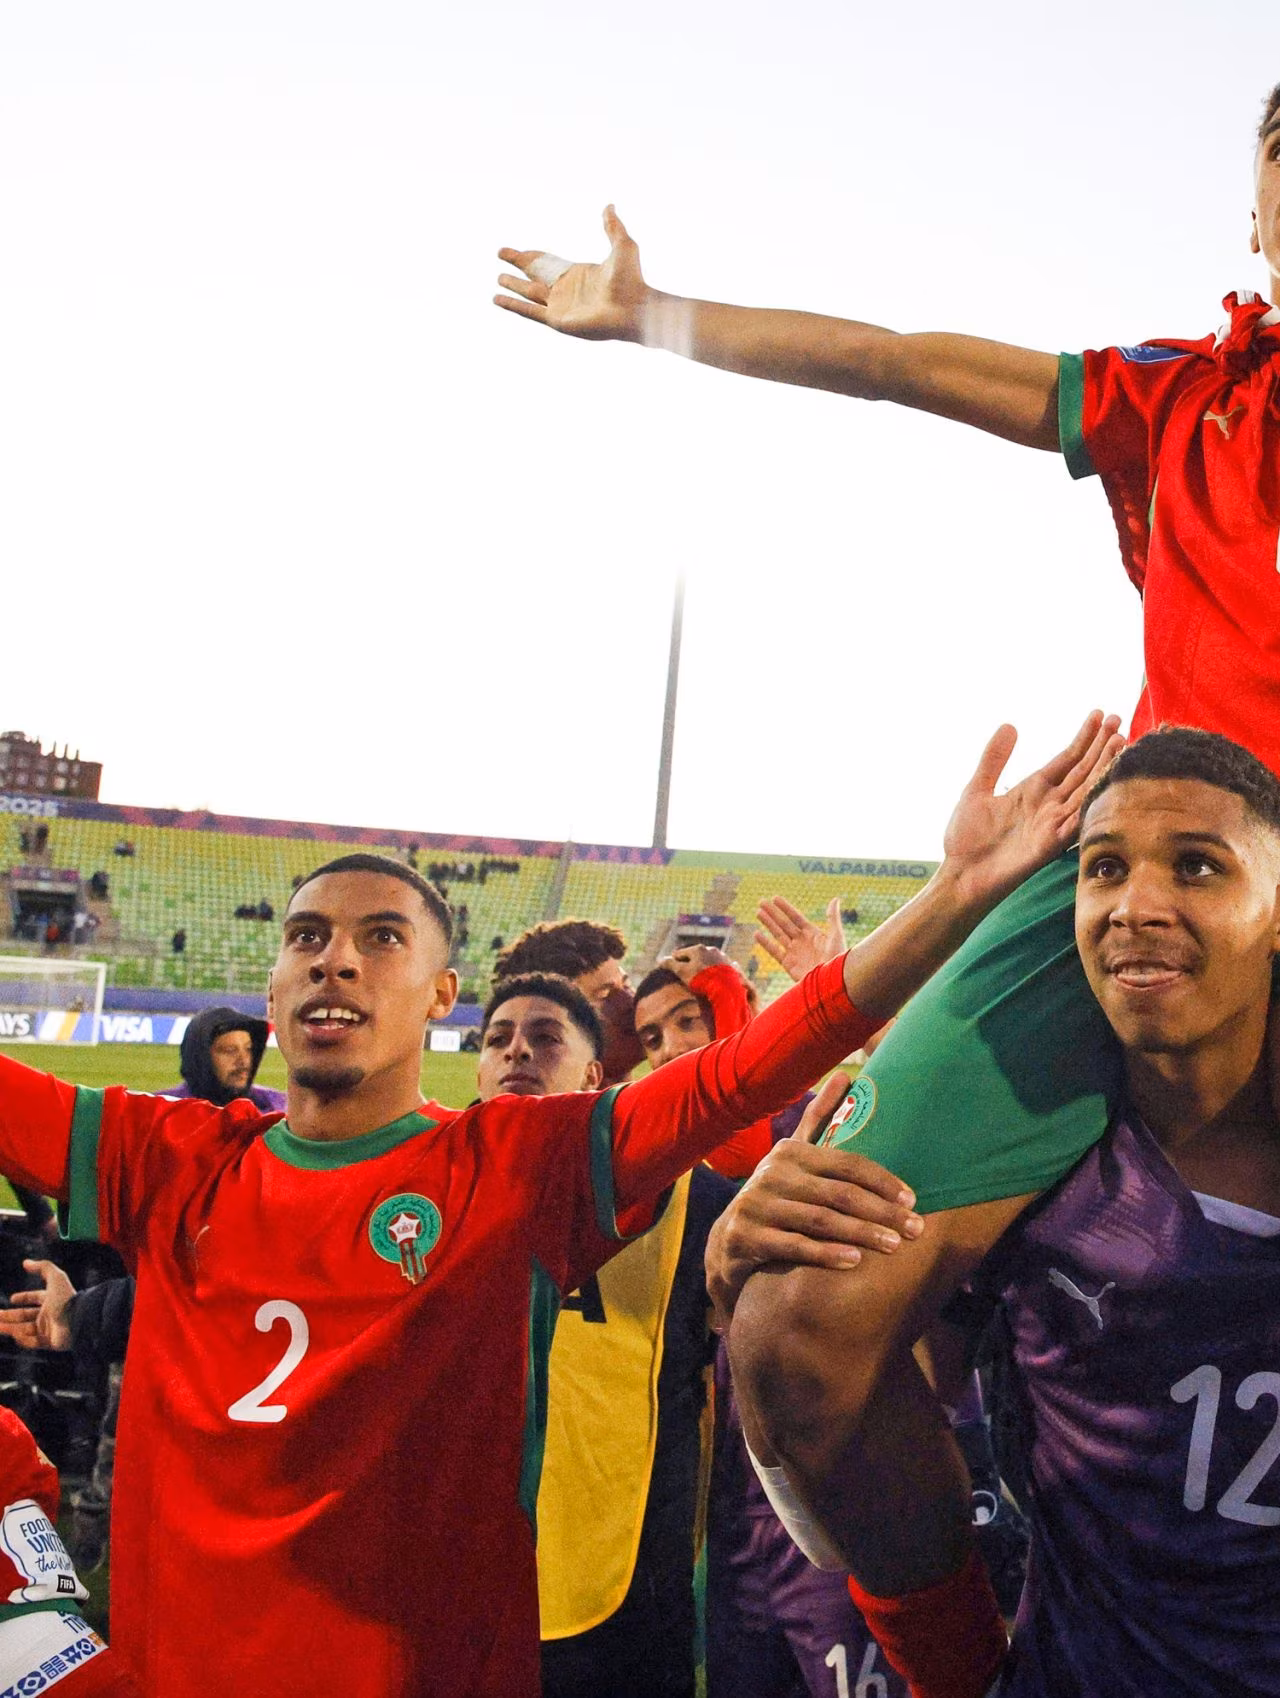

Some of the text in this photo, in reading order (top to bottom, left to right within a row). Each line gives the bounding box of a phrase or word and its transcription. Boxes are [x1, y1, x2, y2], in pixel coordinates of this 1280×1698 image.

[101, 1015, 152, 1042] VISA
[227, 1299, 310, 1423] 2
[35, 1554, 58, 1572] the
[59, 1579, 75, 1590] FIFA
[825, 1643, 888, 1698] 16
